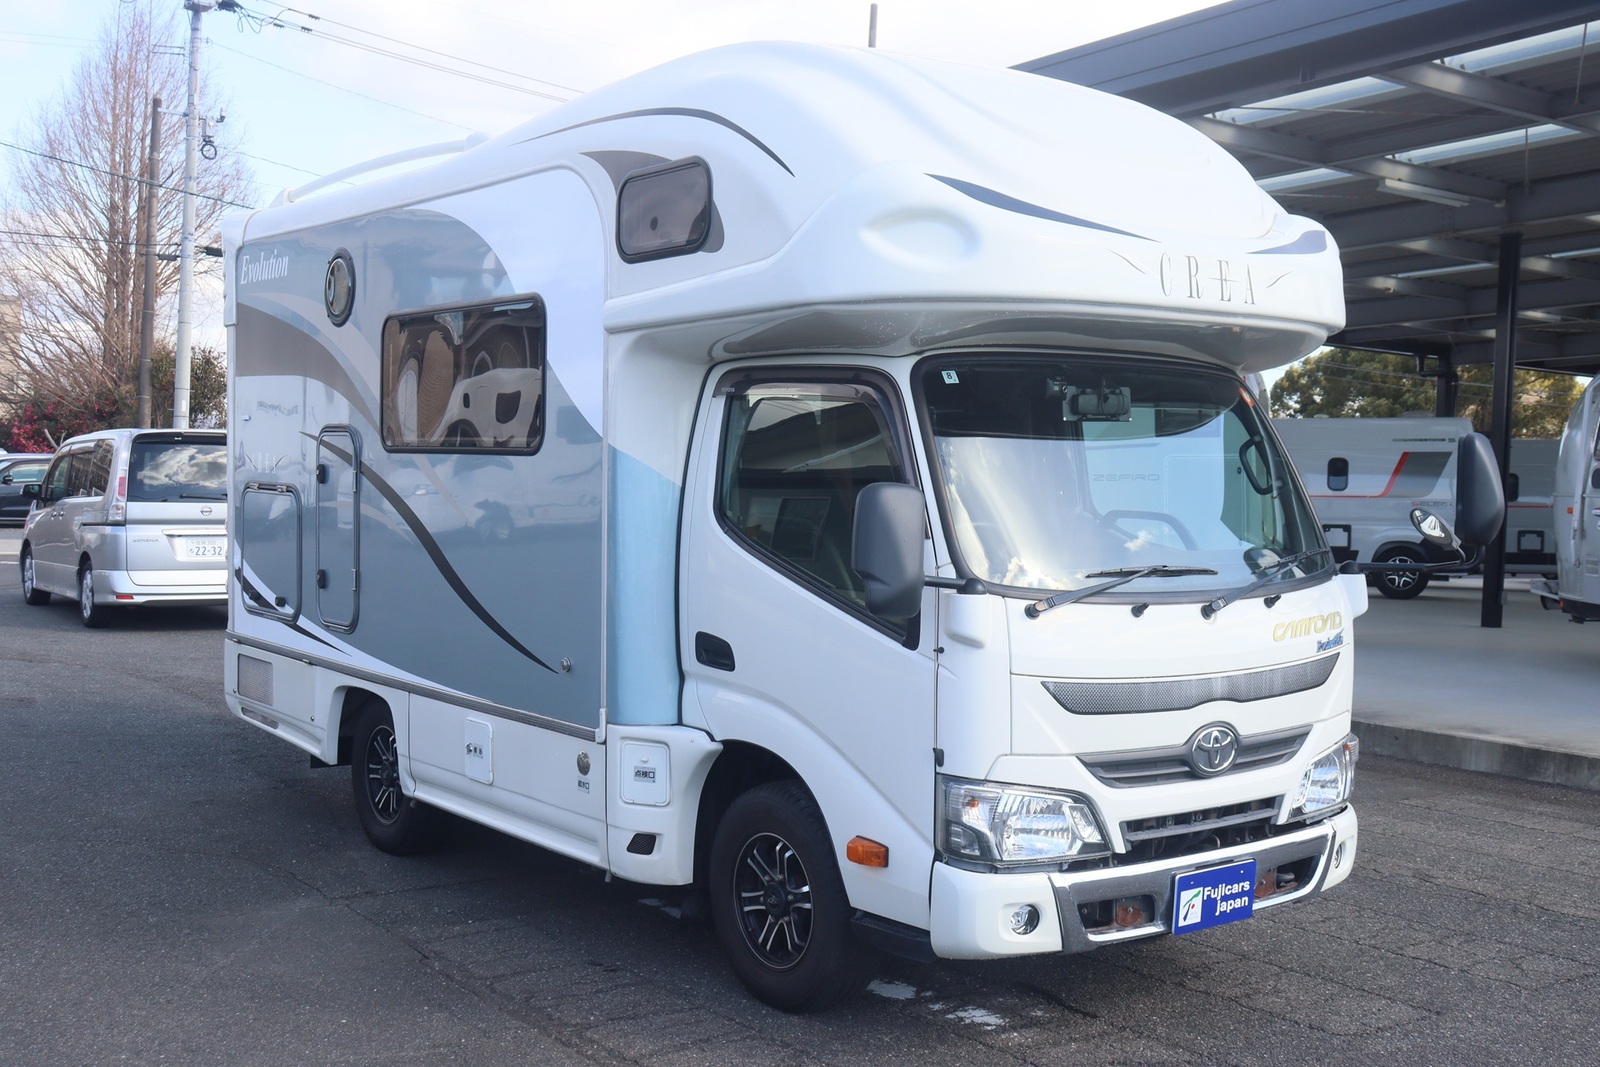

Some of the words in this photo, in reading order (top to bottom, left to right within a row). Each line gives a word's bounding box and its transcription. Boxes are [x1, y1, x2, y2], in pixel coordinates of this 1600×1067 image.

[240, 248, 289, 285] Evolution
[1160, 252, 1256, 305] CREA
[945, 371, 953, 380] 8
[1092, 473, 1160, 481] ZEFIRO
[195, 546, 223, 556] 22-32
[1203, 880, 1251, 900] Fujicars
